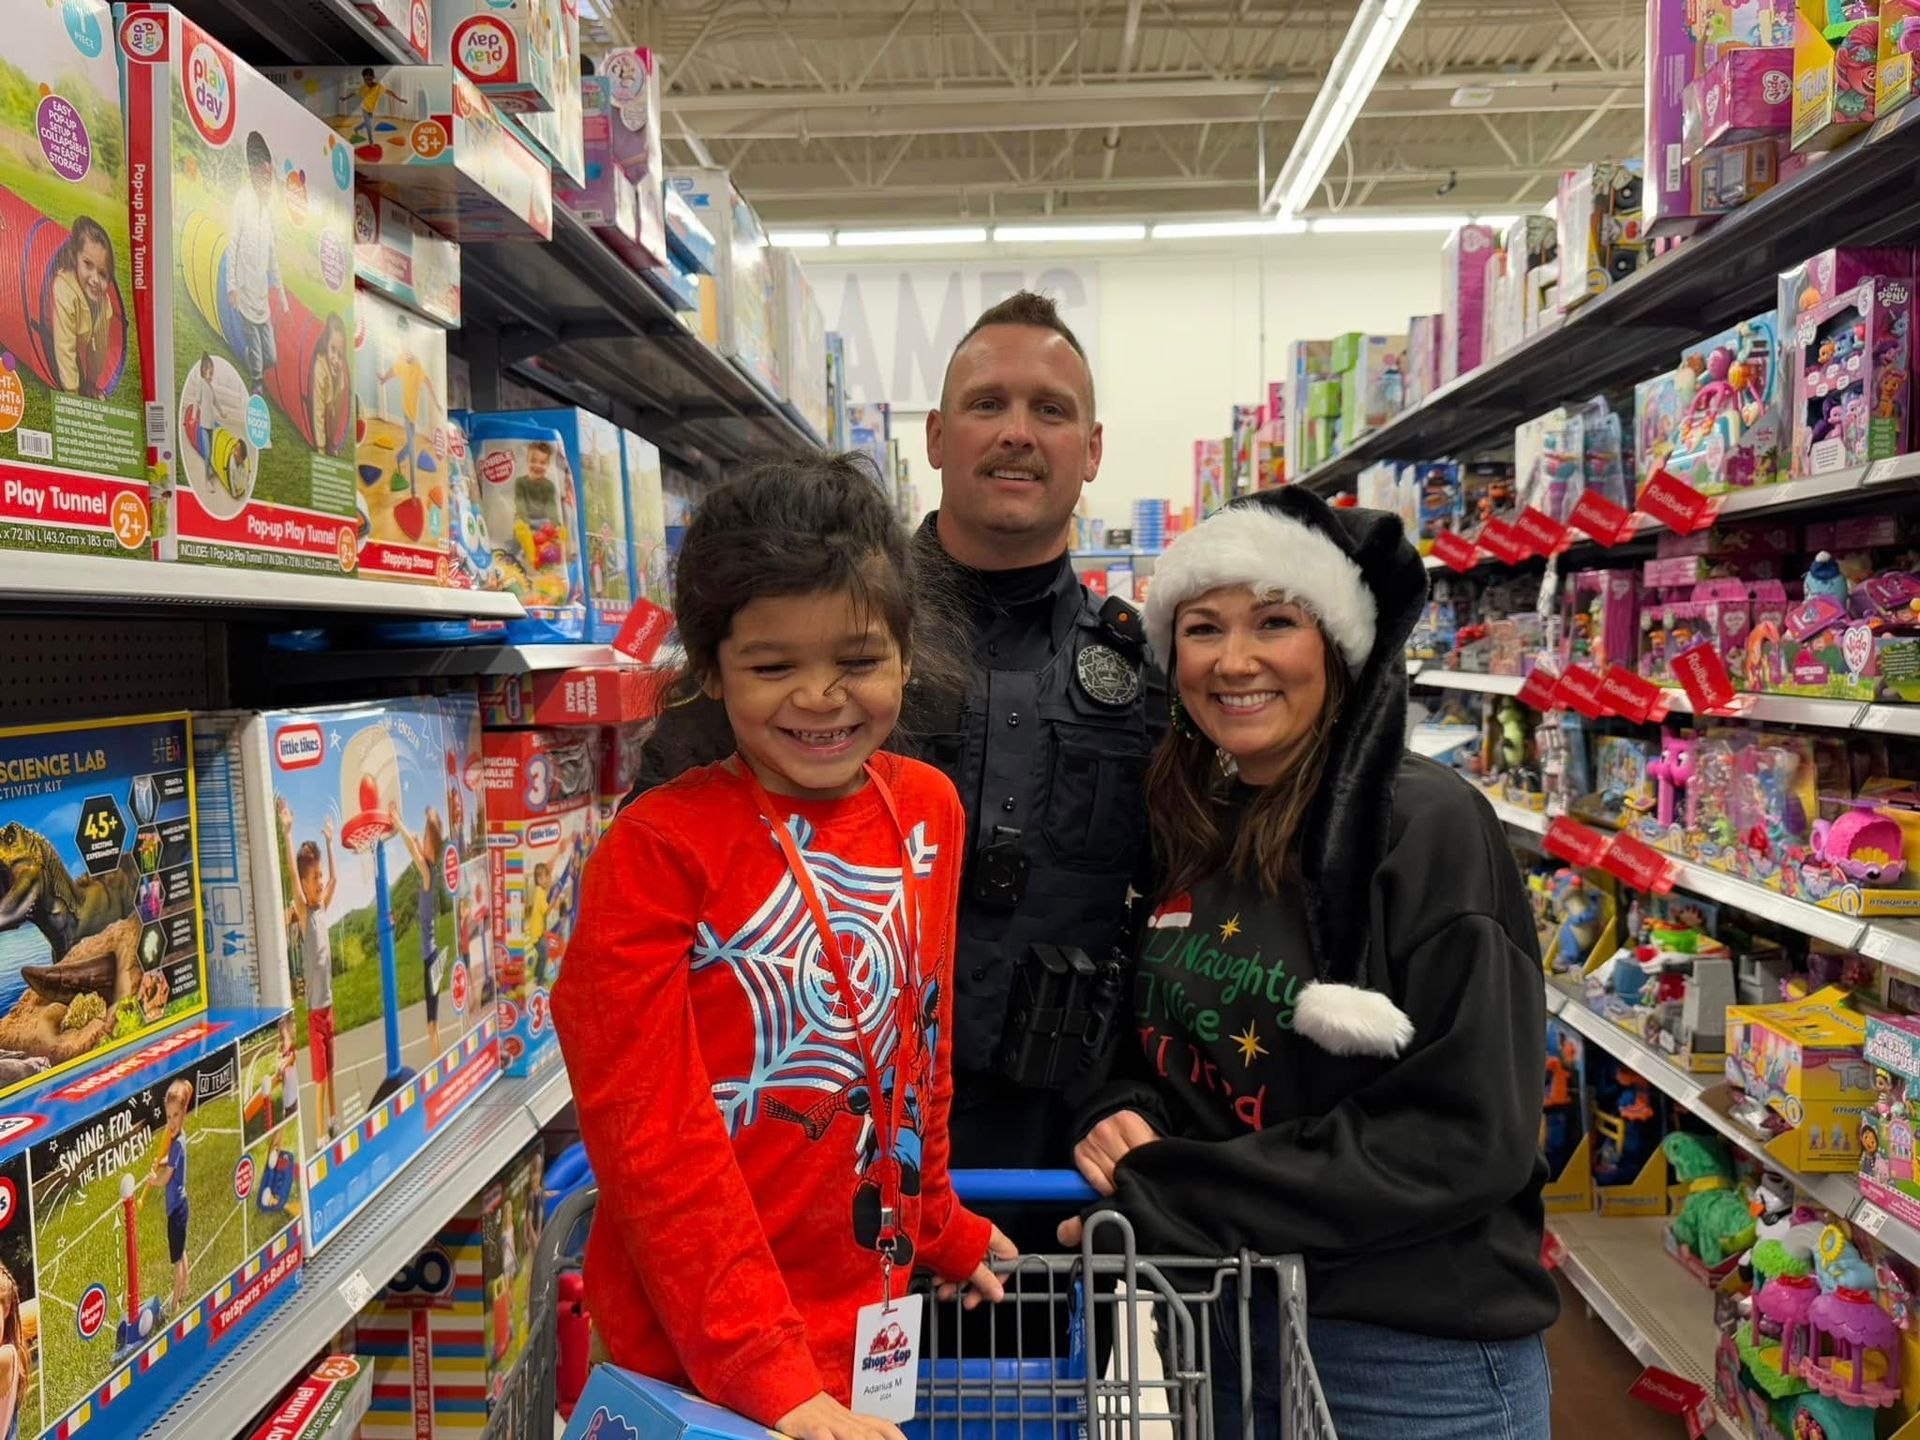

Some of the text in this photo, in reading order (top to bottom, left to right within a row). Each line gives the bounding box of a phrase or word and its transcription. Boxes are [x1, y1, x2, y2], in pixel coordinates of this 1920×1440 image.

[133, 24, 145, 50] day
[142, 22, 155, 52] play
[467, 32, 500, 49] day
[464, 45, 503, 64] play
[193, 58, 226, 97] play
[52, 100, 72, 118] EASY
[195, 85, 223, 122] day
[48, 110, 77, 130] POP-UP
[50, 121, 78, 142] SETUP &
[419, 127, 437, 135] AGES
[40, 128, 88, 157] COLLAPSIBLE
[61, 147, 80, 163] EASY
[416, 135, 442, 153] 3+
[50, 152, 83, 175] STORAGE
[134, 163, 146, 291] Pop-up Play Tunnel
[1877, 291, 1908, 307] PONY
[837, 268, 1088, 401] AM
[5, 480, 107, 515] Play Tunnel
[120, 502, 138, 513] AGES
[1646, 483, 1695, 518] Rollback
[119, 514, 141, 538] 2+
[248, 515, 336, 546] Pop-up Play Tunnel
[1576, 502, 1618, 532] Rollback
[12, 527, 23, 540] 72
[25, 528, 35, 541] IN
[37, 530, 41, 541] L
[44, 530, 65, 545] (43.2
[66, 534, 79, 545] cm
[80, 536, 87, 545] x
[88, 534, 101, 547] 183
[103, 537, 117, 549] cm)
[382, 550, 413, 570] Stepping
[627, 608, 659, 654] Rollback
[1687, 652, 1718, 702] Rollback
[1602, 678, 1648, 708] Rollback
[280, 737, 320, 757] little tikes
[0, 750, 106, 784] SCIENCE LAB
[44, 779, 63, 793] KIT
[528, 760, 547, 805] 3
[84, 810, 119, 840] 45+
[1610, 845, 1653, 877] Rollback
[1174, 931, 1298, 1029] Naughty
[1162, 980, 1220, 1042] Nice
[1867, 1040, 1919, 1077] DOLLHOUSE
[200, 1066, 232, 1093] GO TEAM!
[1828, 1059, 1872, 1092] Tro
[109, 1108, 133, 1141] FOR
[78, 1126, 153, 1187] THE FENCES!!
[220, 1249, 299, 1328] TotSports T-Ball Set
[324, 1360, 349, 1377] 2+
[414, 1335, 428, 1388] PLAYING
[862, 1355, 887, 1371] Shop
[894, 1348, 911, 1363] Cop
[895, 1377, 902, 1388] M
[1640, 1377, 1687, 1404] Rollback
[272, 1387, 317, 1424] Tunnel
